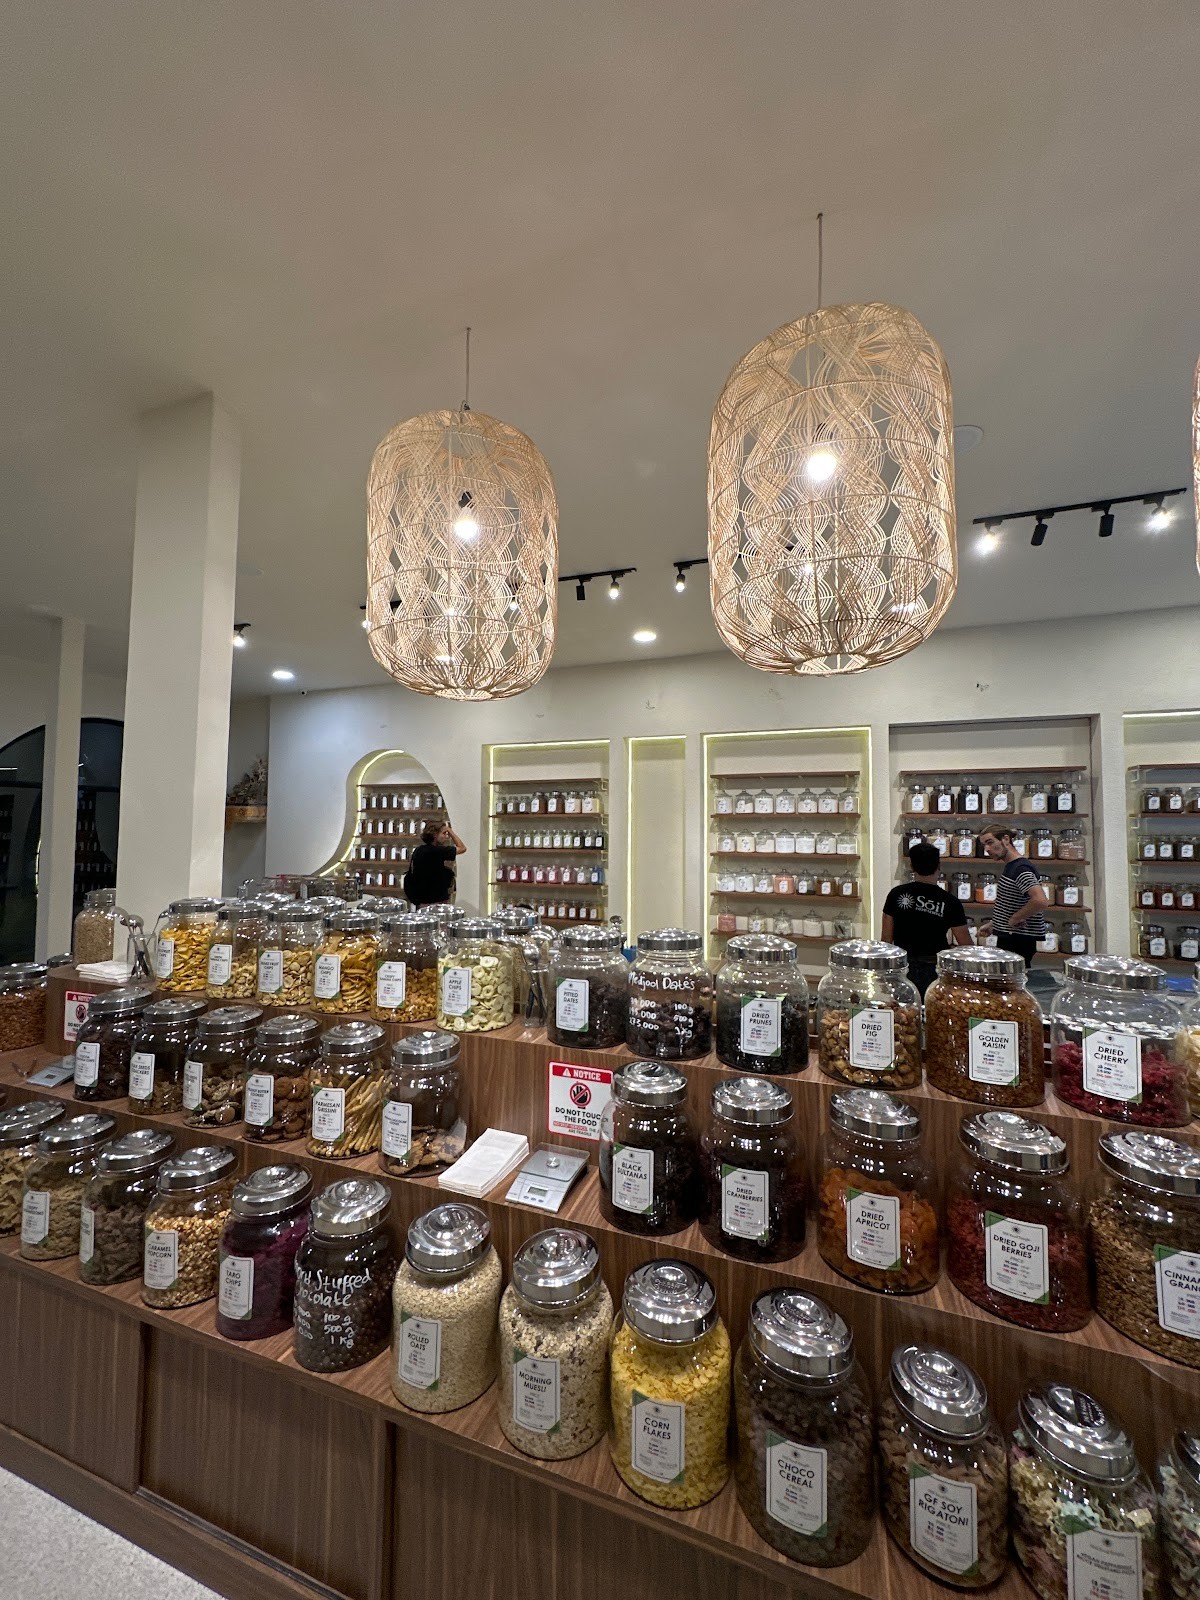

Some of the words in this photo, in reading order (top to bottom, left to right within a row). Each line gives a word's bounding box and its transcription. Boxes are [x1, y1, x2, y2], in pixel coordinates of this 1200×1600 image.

[628, 972, 658, 991] Medjool
[979, 1035, 1009, 1043] GOLDEN
[1098, 1046, 1123, 1056] DRIED
[1094, 1053, 1129, 1064] CHERRY
[573, 1070, 601, 1081] NOTICE
[583, 1112, 601, 1120] TOUC
[578, 1118, 597, 1126] FOOD
[622, 1162, 642, 1171] BLACK
[617, 1168, 647, 1180] SULTANAS
[727, 1190, 763, 1202] CRANBERRIES
[736, 1187, 752, 1195] DRIED
[861, 1211, 884, 1221] DRIED
[856, 1218, 890, 1230] APRICOT
[148, 1244, 171, 1252] CARAMEL
[994, 1234, 1016, 1247] DRIED
[1020, 1243, 1040, 1252] GOJI
[1002, 1245, 1032, 1259] BERRIES
[226, 1270, 241, 1279] TARO
[226, 1278, 241, 1287] CHIPS
[315, 1267, 372, 1294] Stuffed
[1169, 1280, 1200, 1292] GRAN
[324, 1313, 340, 1322] 100
[324, 1324, 342, 1334] 500
[407, 1333, 429, 1344] ROLLED
[410, 1341, 426, 1351] OATS
[519, 1371, 552, 1385] MORNING
[524, 1381, 547, 1392] MUESLI
[645, 1417, 670, 1430] CORN
[643, 1425, 671, 1440] FLAKES
[778, 1459, 815, 1479] CHOCO
[780, 1469, 813, 1488] CEREAL
[924, 1493, 938, 1505] GF
[941, 1501, 962, 1514] SOY
[918, 1498, 969, 1526] RIGATONI
